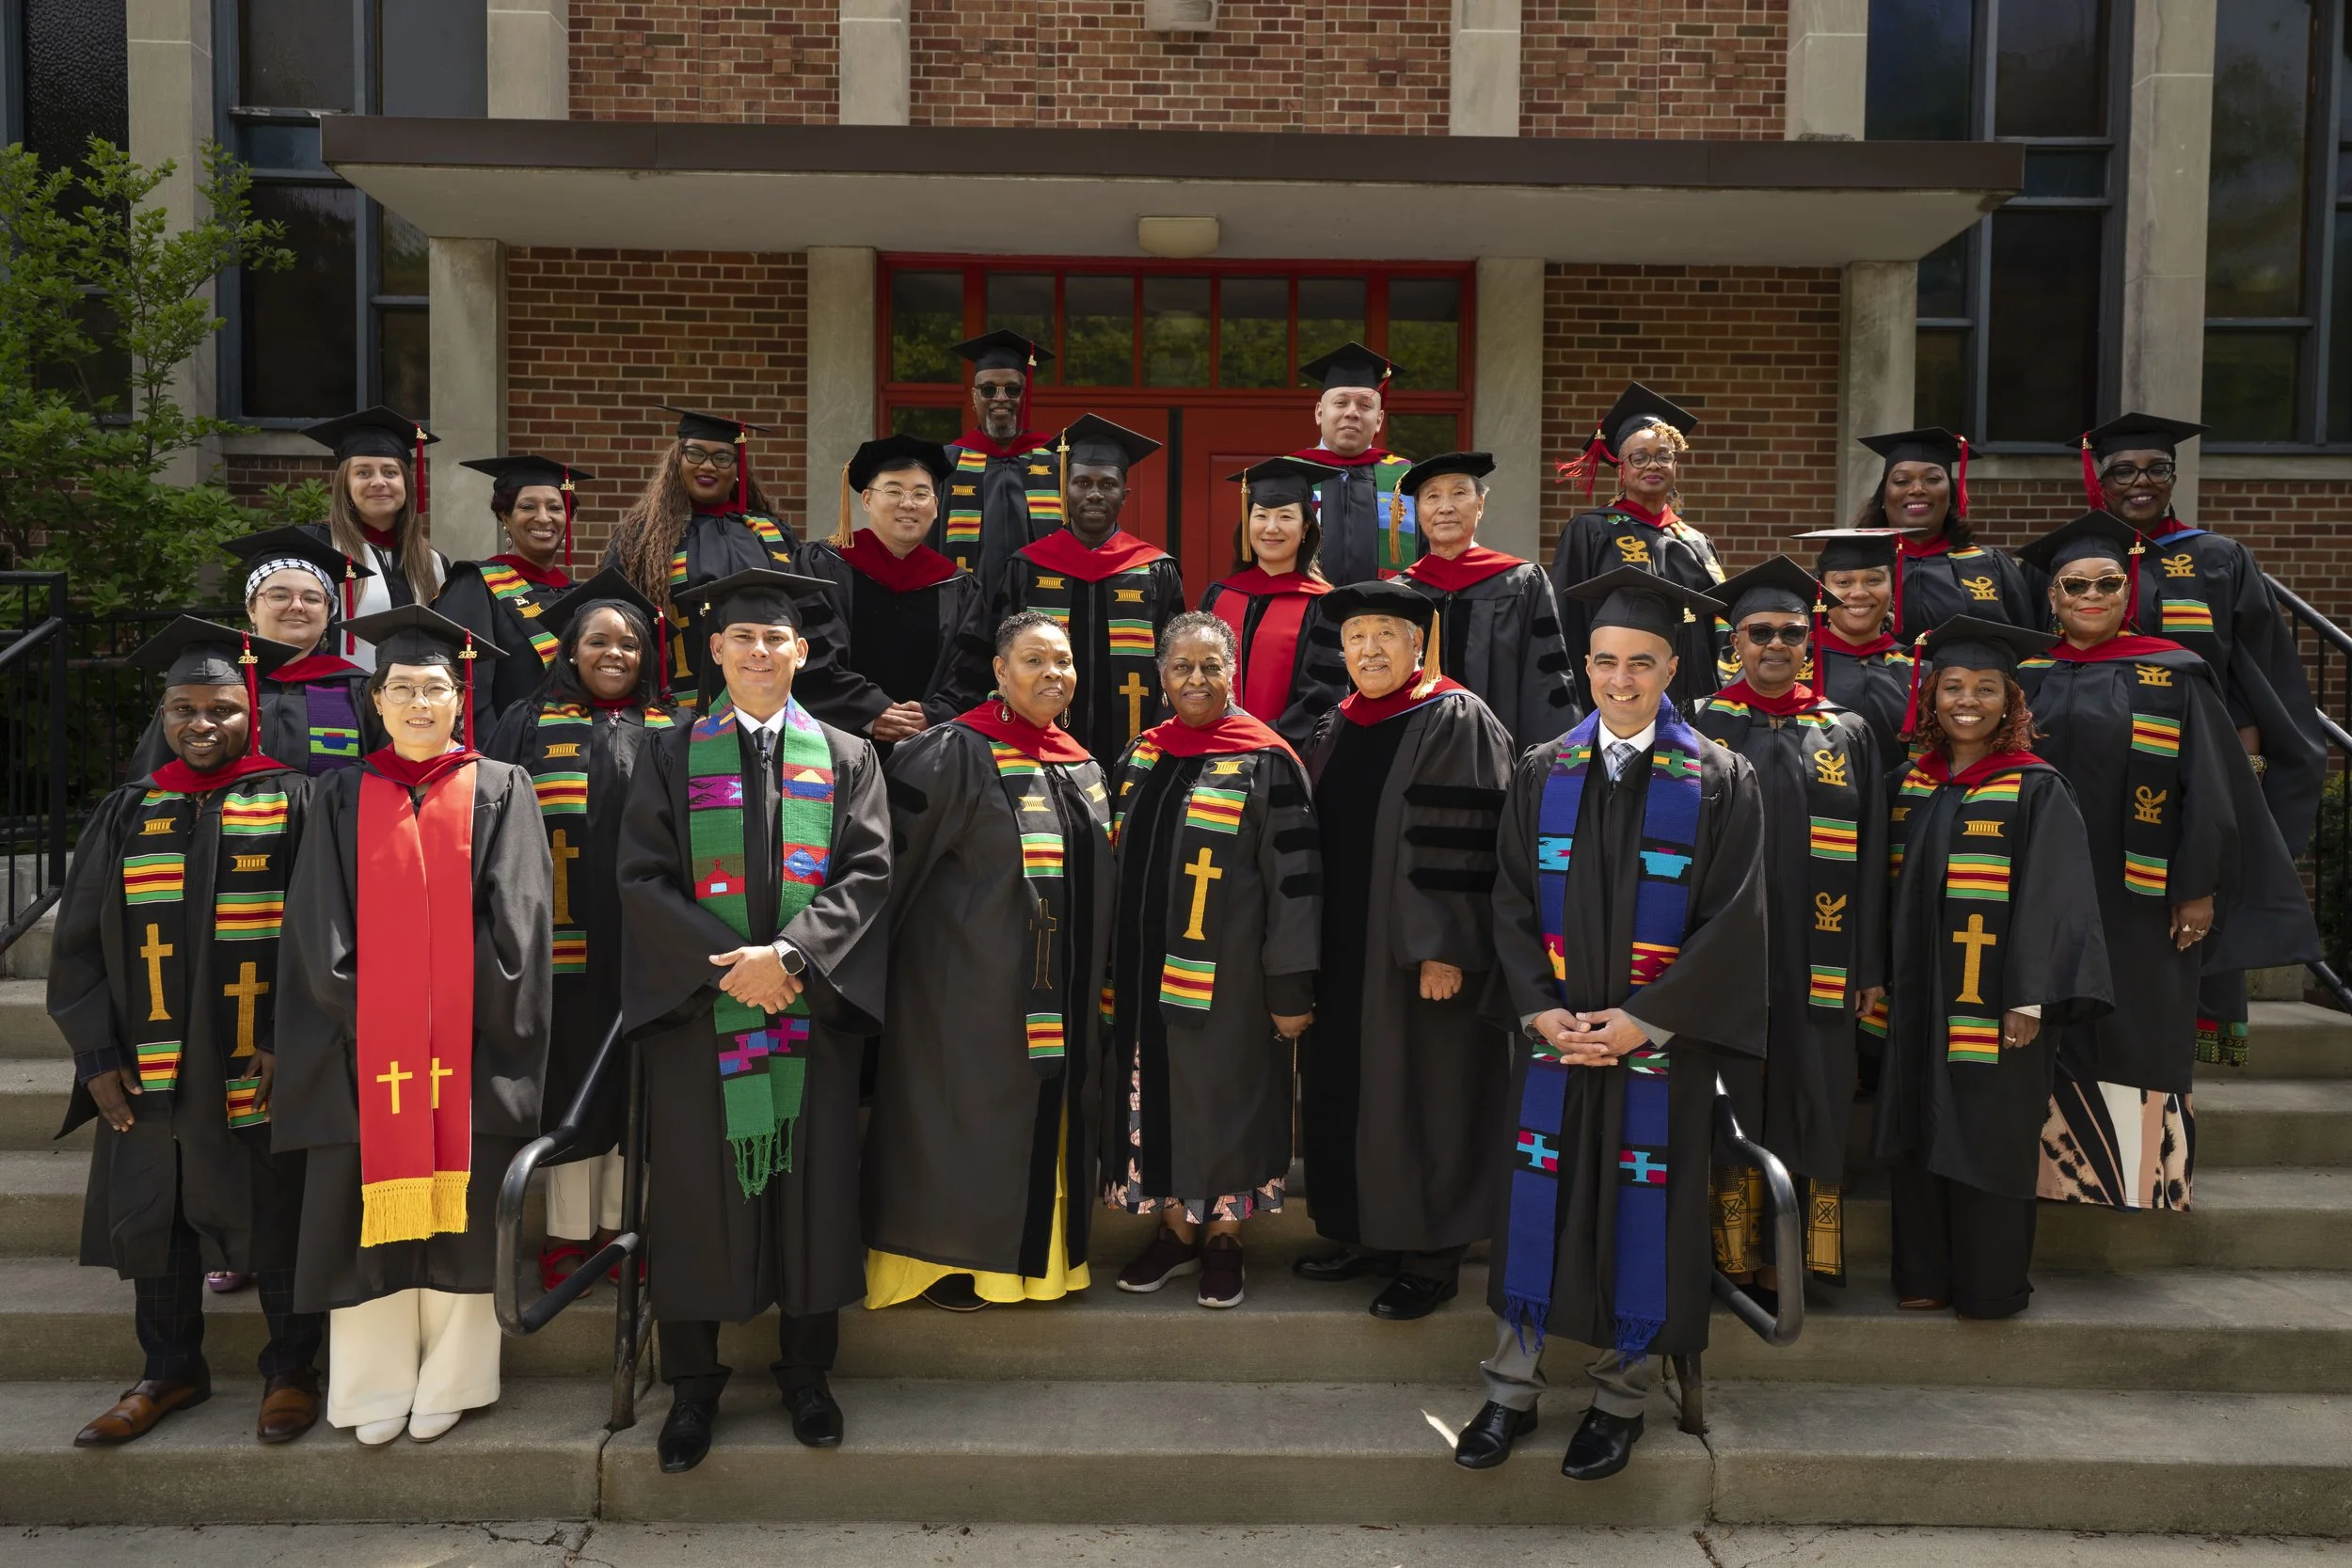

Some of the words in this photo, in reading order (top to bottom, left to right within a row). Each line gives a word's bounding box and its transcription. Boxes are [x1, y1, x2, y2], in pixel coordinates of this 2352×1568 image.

[2127, 546, 2146, 555] 2026
[458, 650, 478, 659] 2026
[238, 656, 259, 664] 2026
